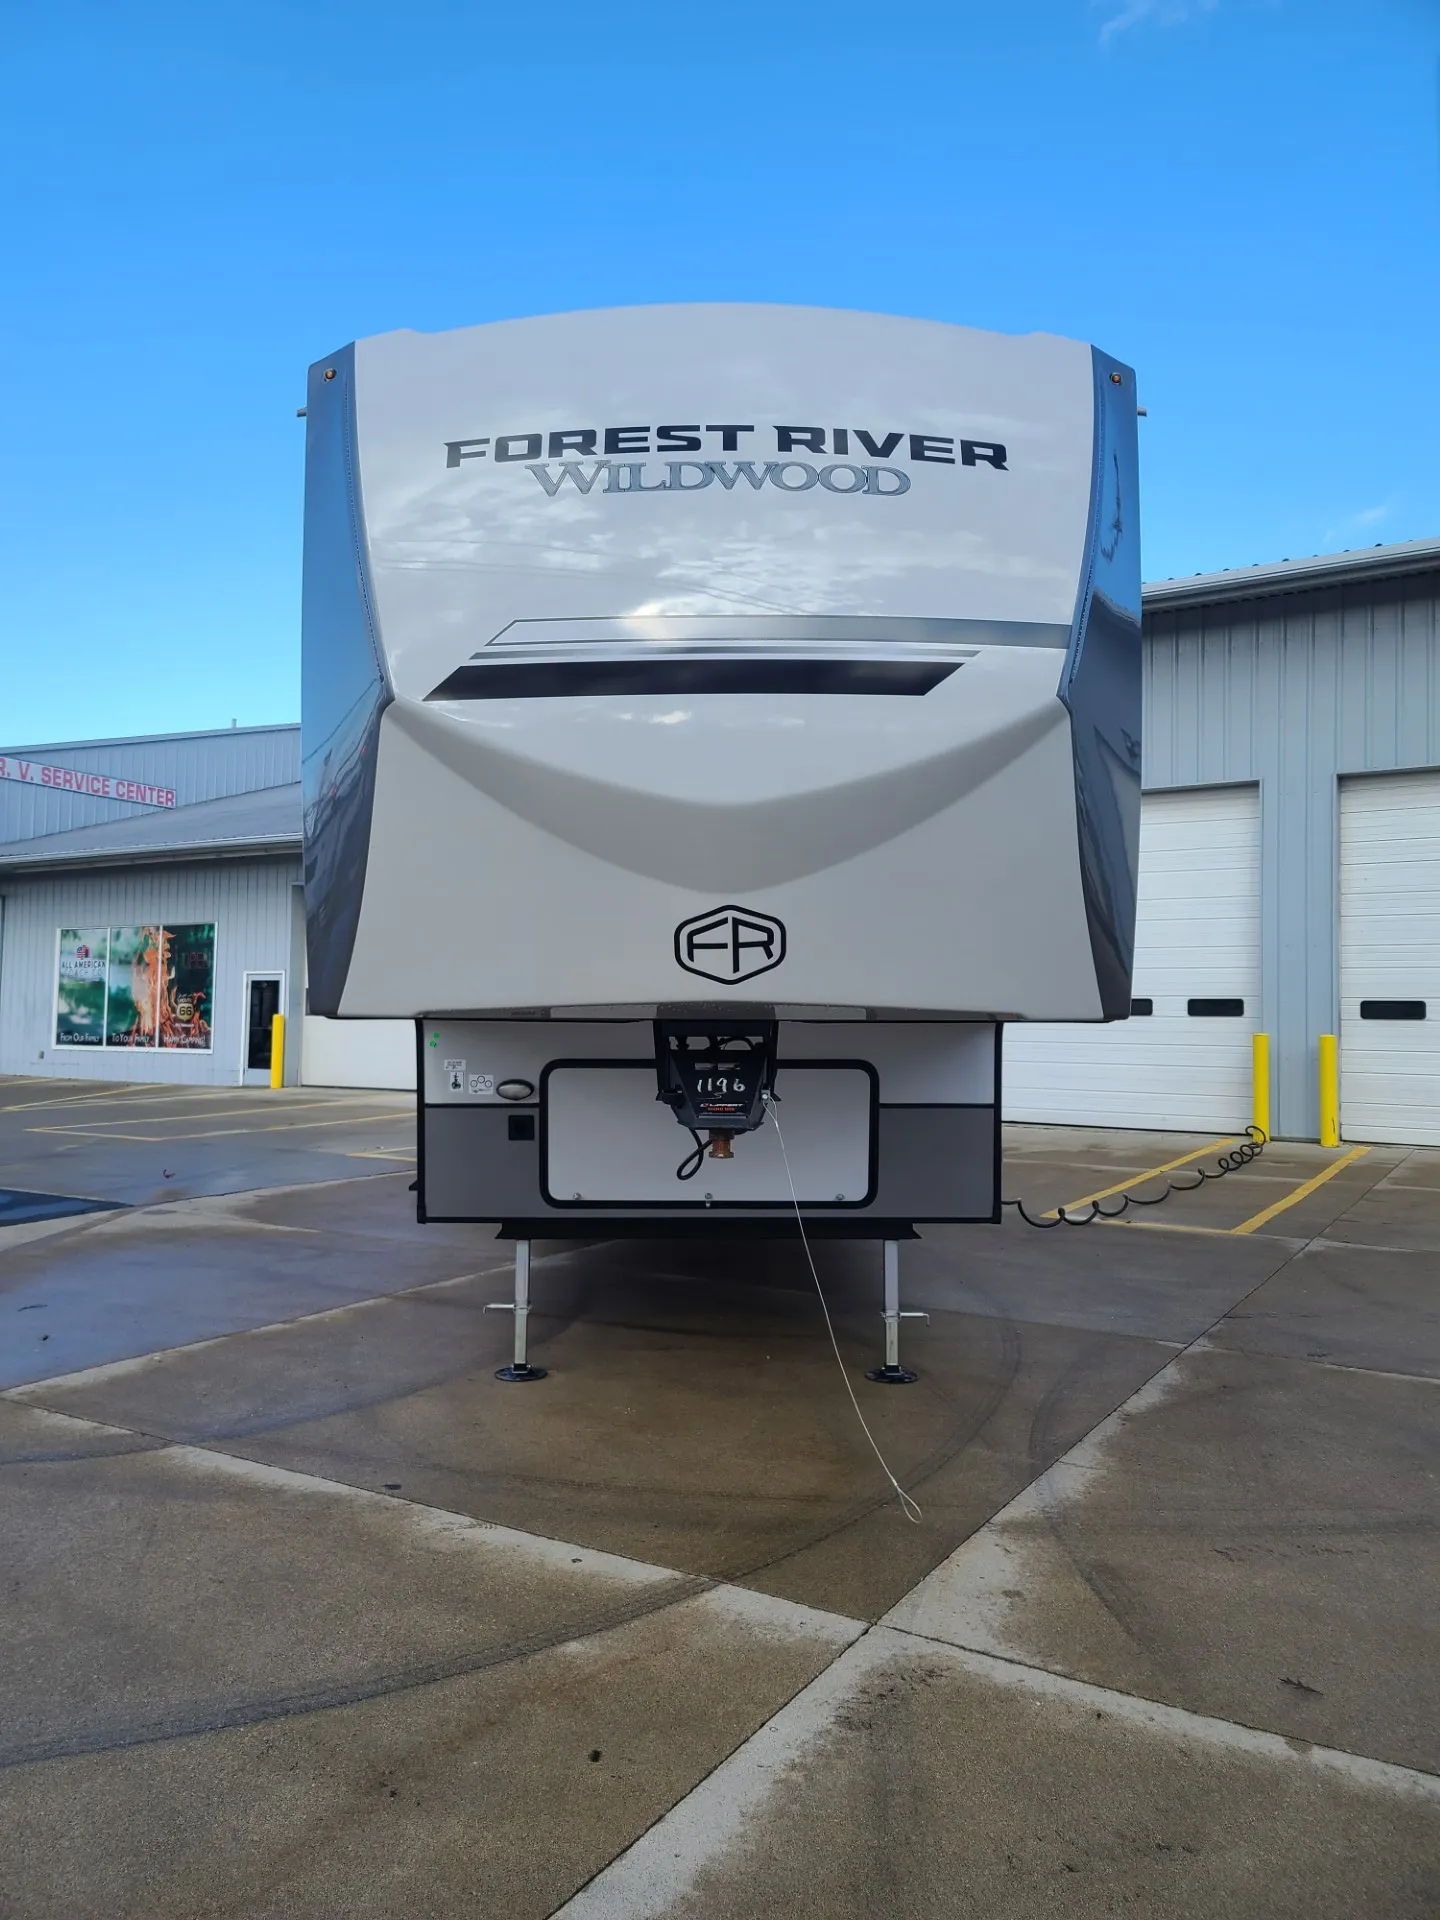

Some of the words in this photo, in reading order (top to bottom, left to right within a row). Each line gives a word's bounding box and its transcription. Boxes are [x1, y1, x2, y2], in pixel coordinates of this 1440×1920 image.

[443, 424, 755, 469] FOREST
[772, 425, 1011, 471] RIVER
[524, 459, 912, 497] WILDWOOD
[41, 766, 110, 796] SERVICE
[115, 781, 175, 807] CENTER
[180, 1006, 192, 1016] 66
[697, 1077, 746, 1093] 1196
